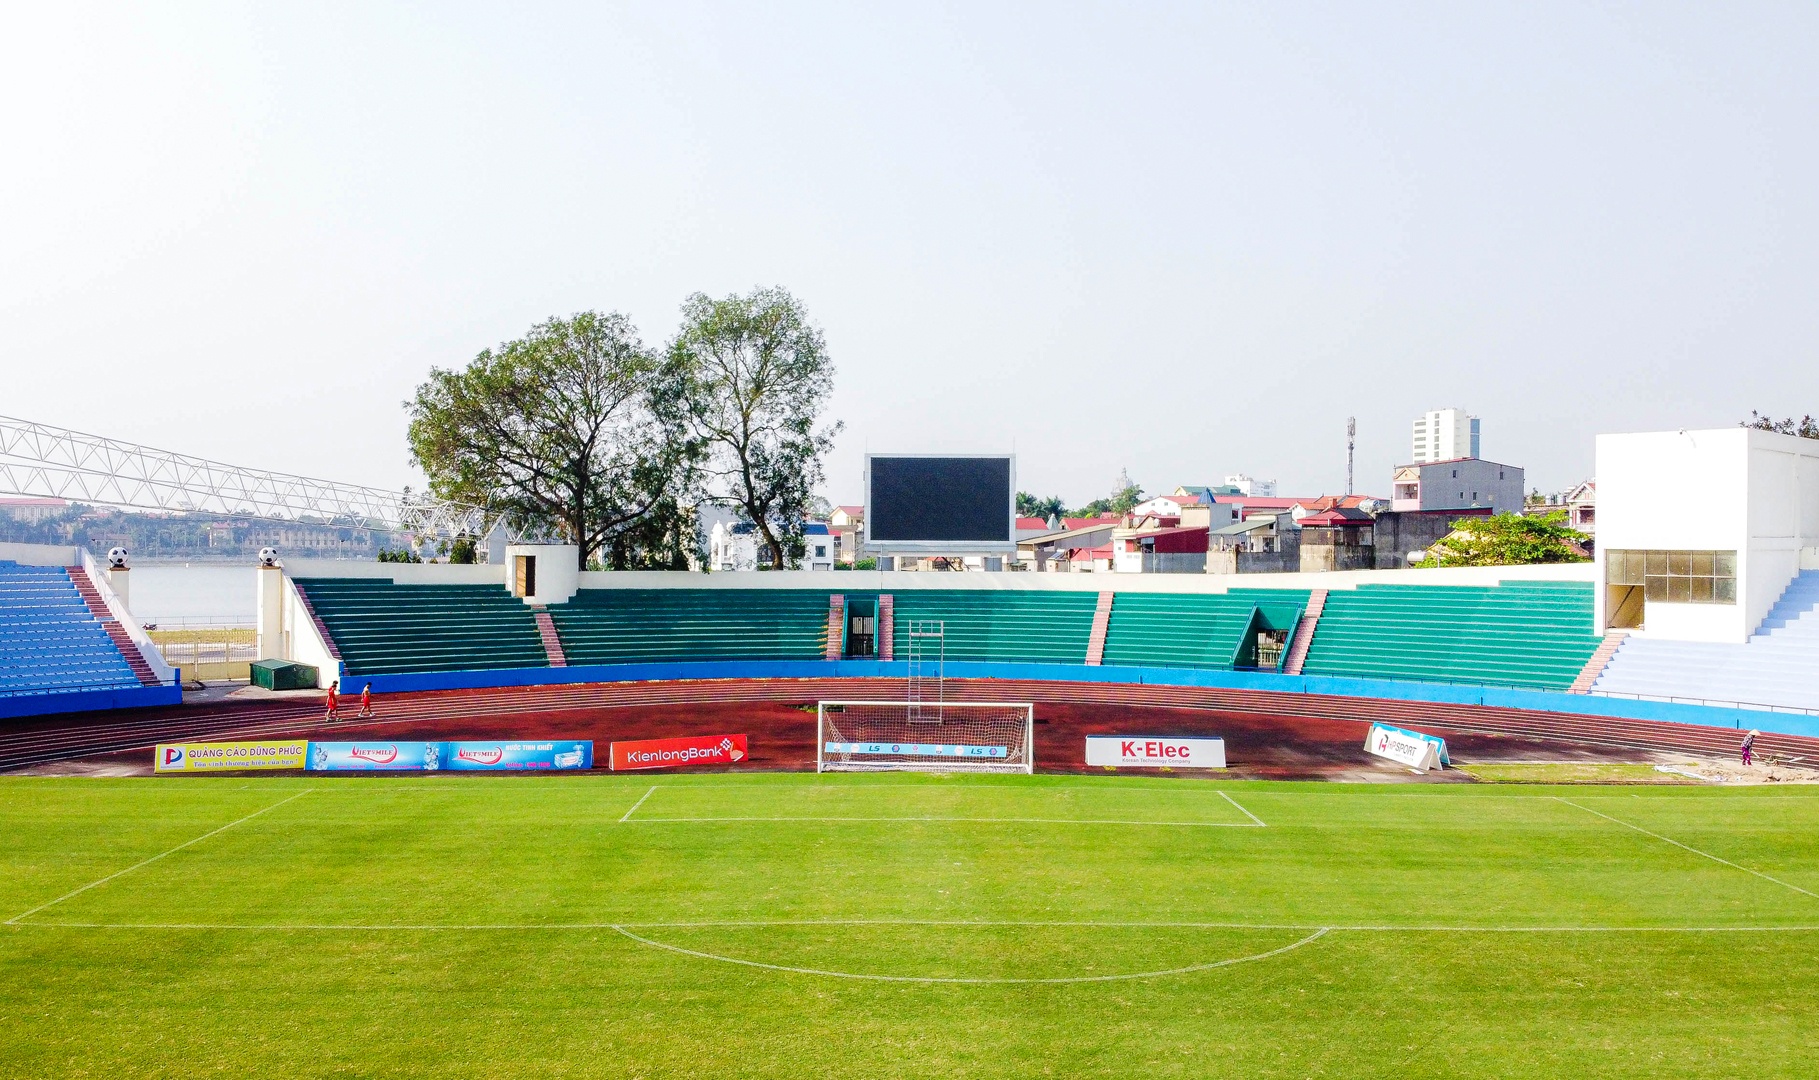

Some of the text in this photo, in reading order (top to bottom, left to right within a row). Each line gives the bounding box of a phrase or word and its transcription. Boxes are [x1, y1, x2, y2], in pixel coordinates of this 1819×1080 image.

[188, 746, 224, 758] QUẢNG
[278, 744, 303, 755] PHÚC
[627, 745, 723, 763] KienlongBank
[1121, 741, 1190, 758] K-Elec
